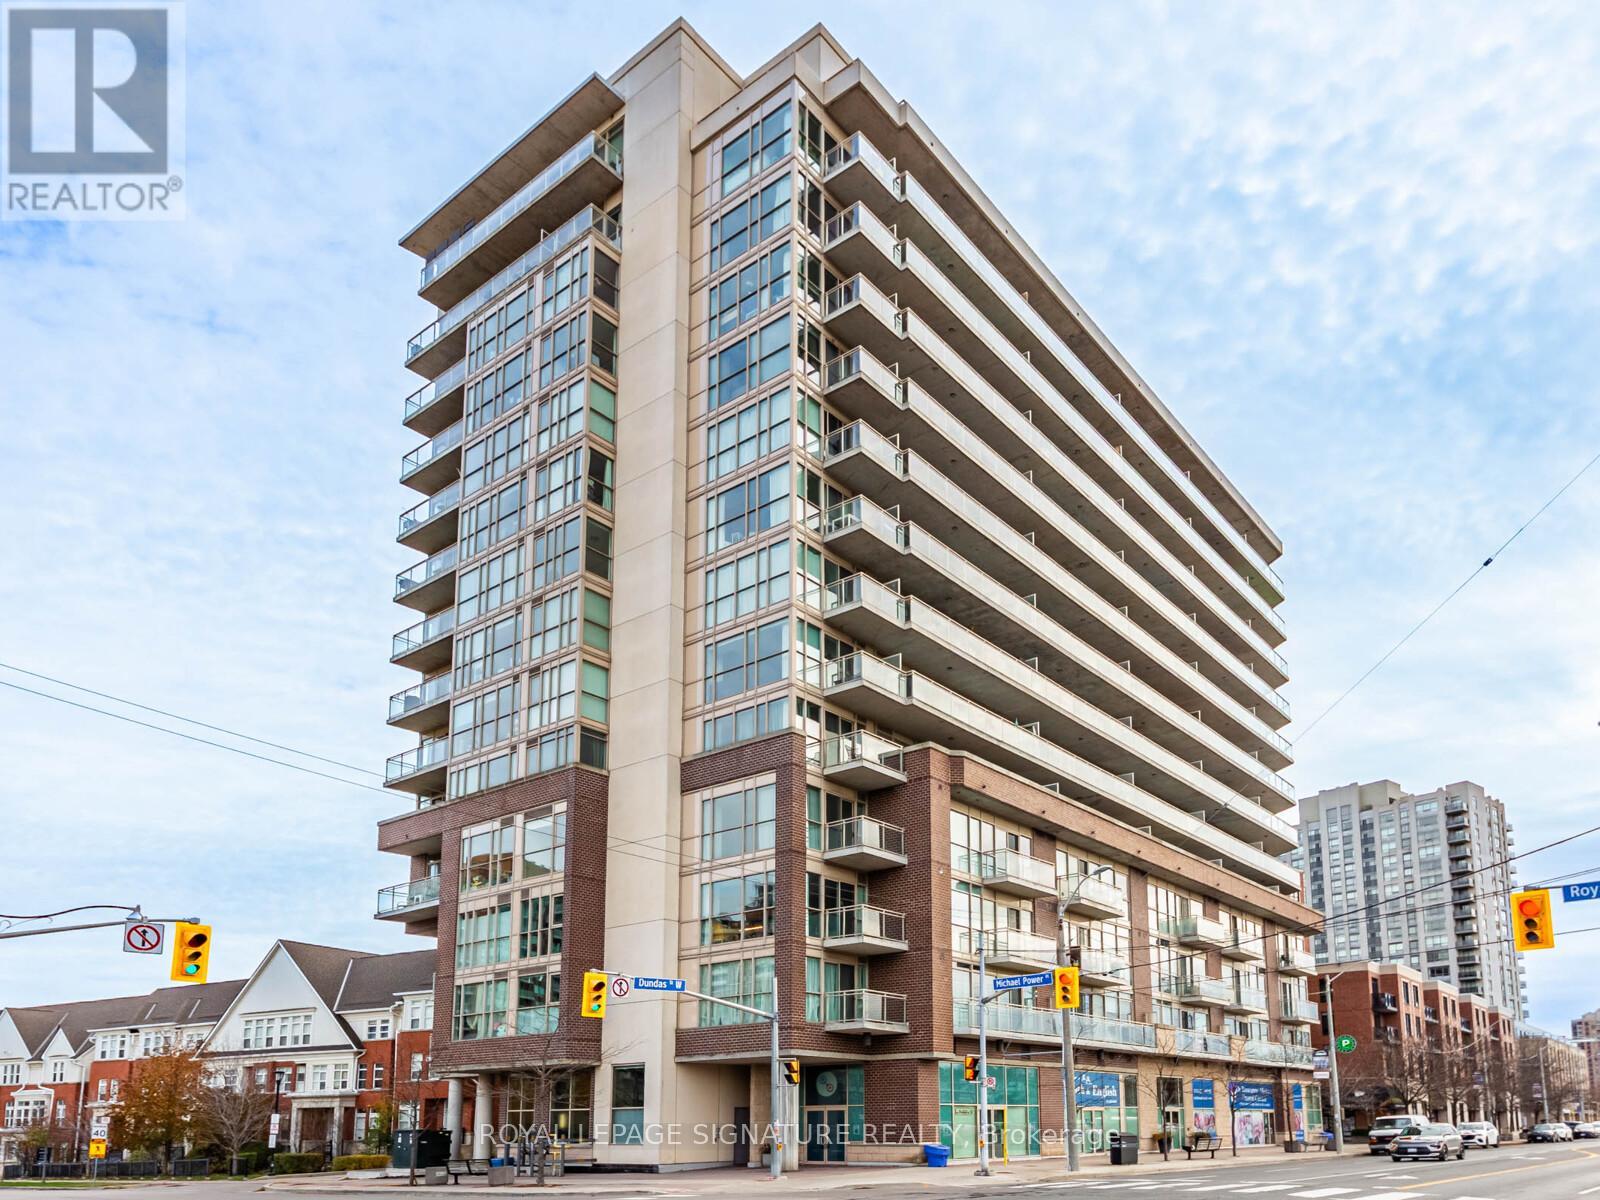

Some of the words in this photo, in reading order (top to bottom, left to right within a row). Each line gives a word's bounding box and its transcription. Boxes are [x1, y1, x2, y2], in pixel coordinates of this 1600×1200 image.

[639, 978, 667, 988] Dundas
[675, 980, 682, 989] W
[996, 978, 1021, 987] Michael
[1022, 976, 1043, 985] Power
[1092, 1084, 1118, 1098] English
[93, 1129, 106, 1138] 40
